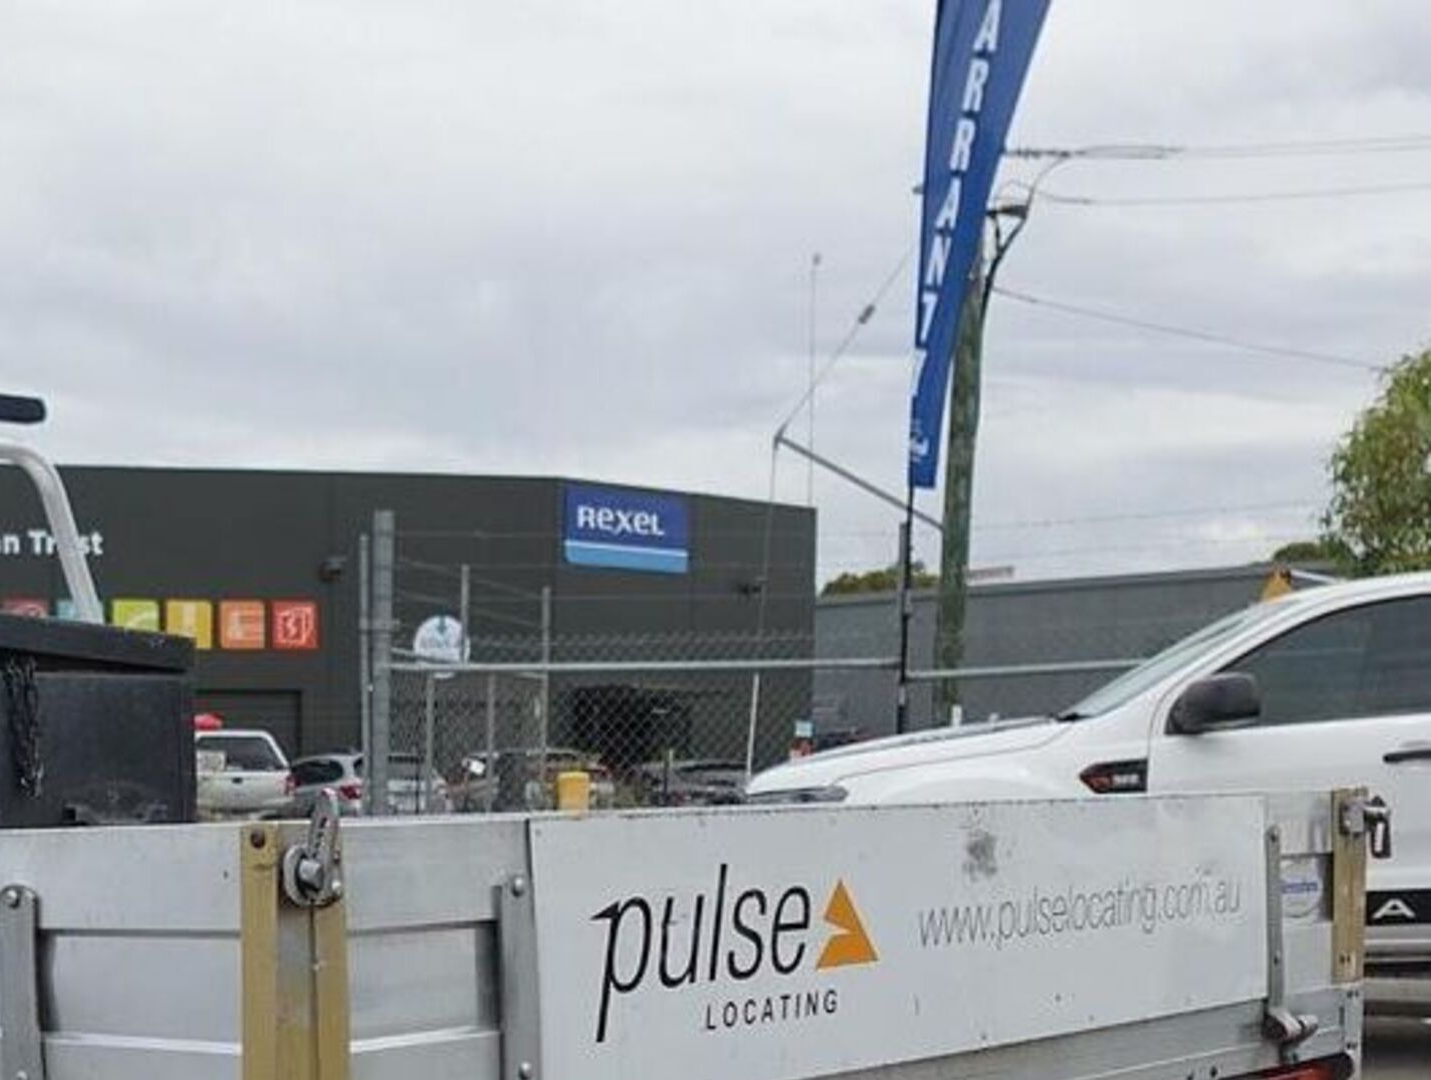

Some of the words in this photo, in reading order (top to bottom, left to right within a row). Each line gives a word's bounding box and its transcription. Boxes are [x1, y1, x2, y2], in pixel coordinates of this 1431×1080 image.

[27, 529, 104, 556] Trst
[917, 876, 1242, 949] www.pulselocating.com.au
[591, 862, 812, 1043] pulse
[705, 989, 839, 1031] LOCATING
